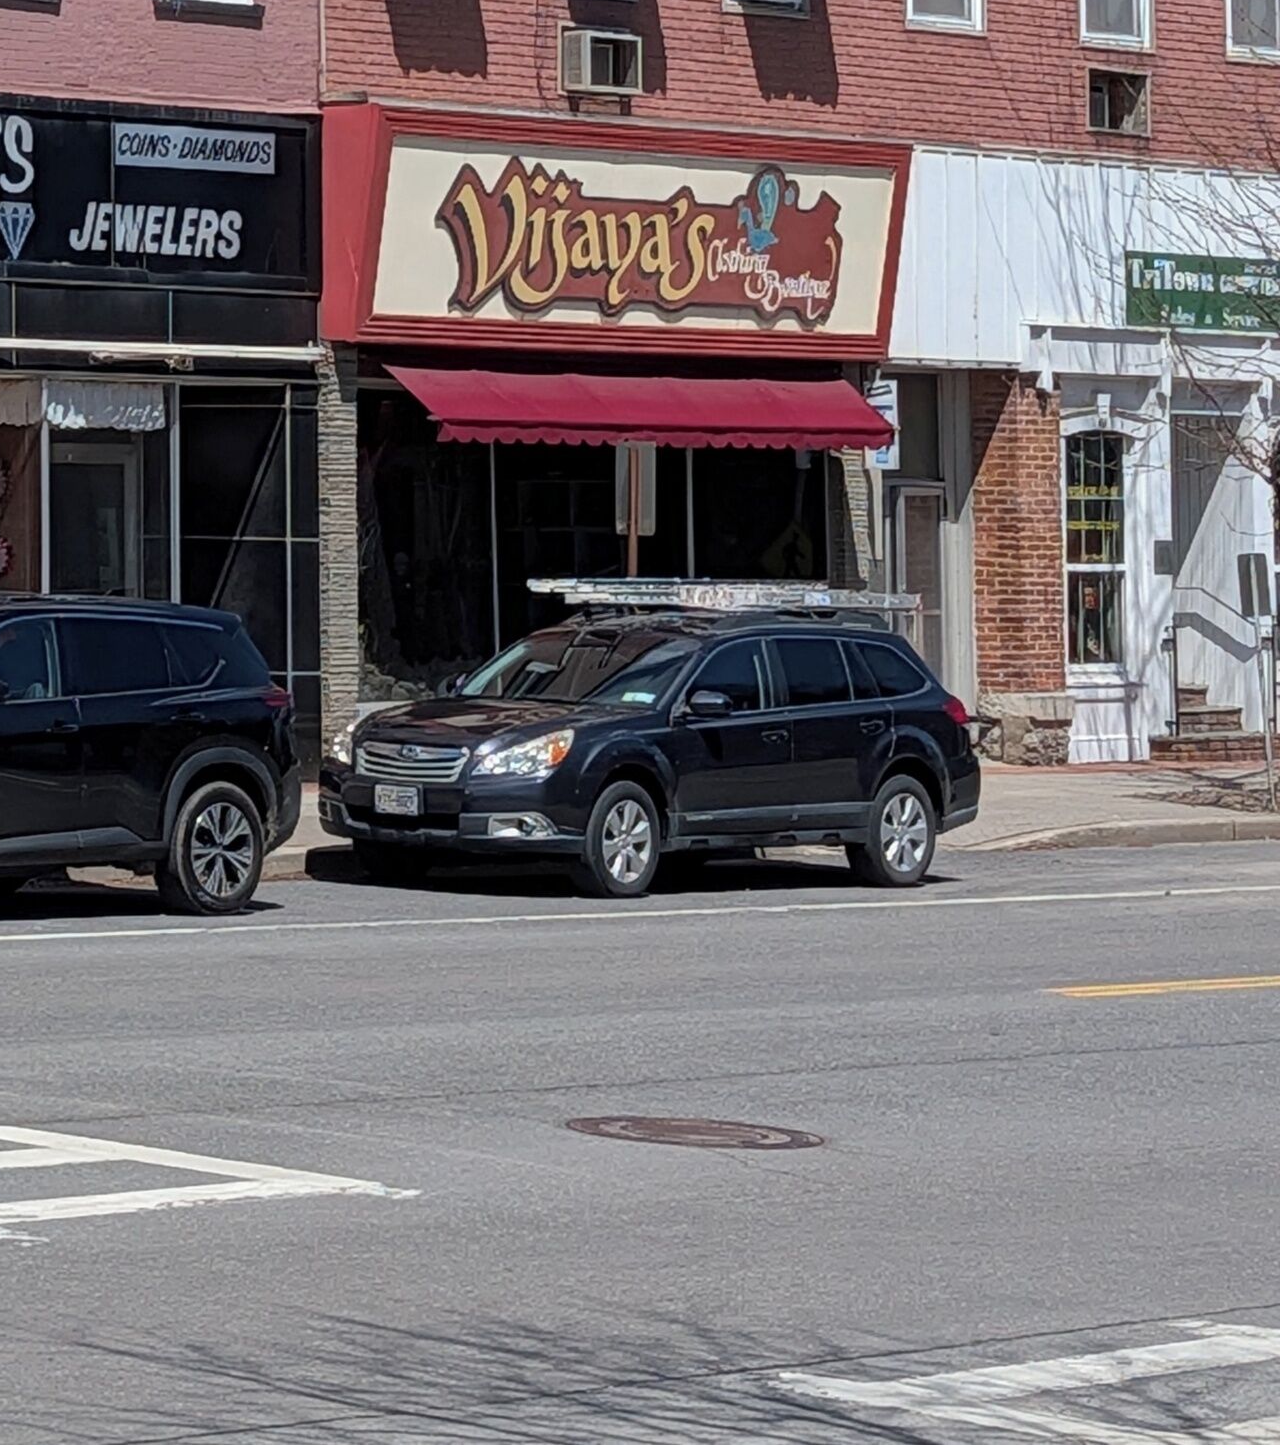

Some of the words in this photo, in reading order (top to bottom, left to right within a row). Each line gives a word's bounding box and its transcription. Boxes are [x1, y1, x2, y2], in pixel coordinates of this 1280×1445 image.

[117, 132, 171, 156] COINS
[178, 136, 273, 165] DIAMONDS
[68, 201, 243, 260] JEWELERS
[454, 173, 716, 305] Vijaya's
